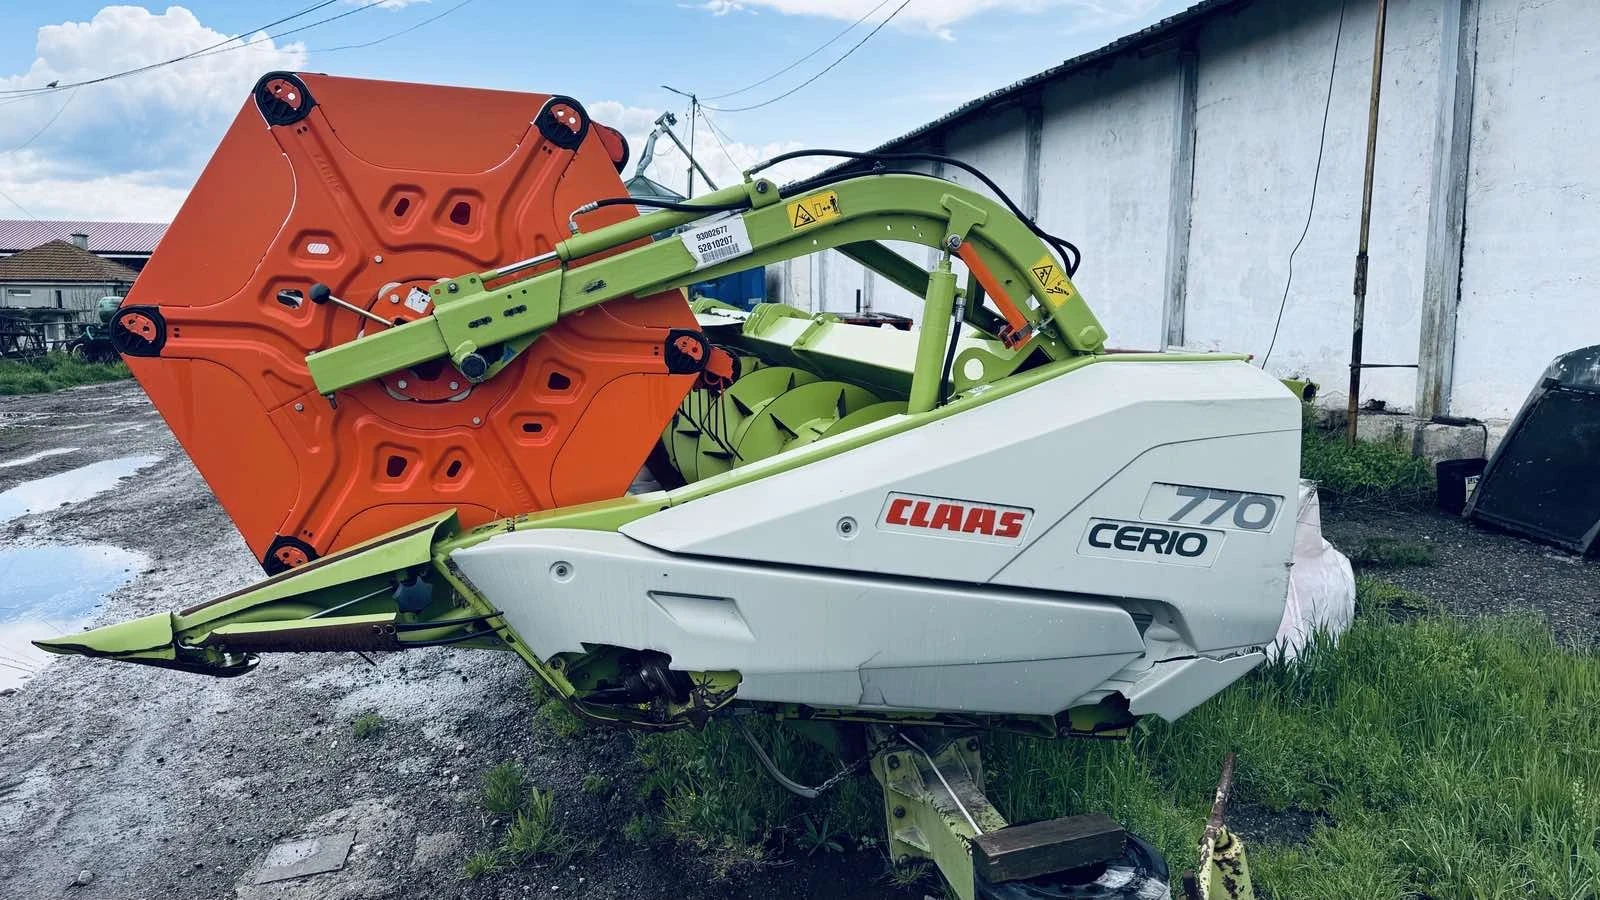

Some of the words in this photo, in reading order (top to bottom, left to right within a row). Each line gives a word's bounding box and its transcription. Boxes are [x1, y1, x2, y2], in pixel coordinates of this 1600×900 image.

[696, 225, 728, 242] 93002677
[697, 235, 733, 254] 52810207
[885, 498, 1026, 538] CLAAS
[1168, 487, 1276, 530] 770
[1088, 523, 1208, 558] CERIO
